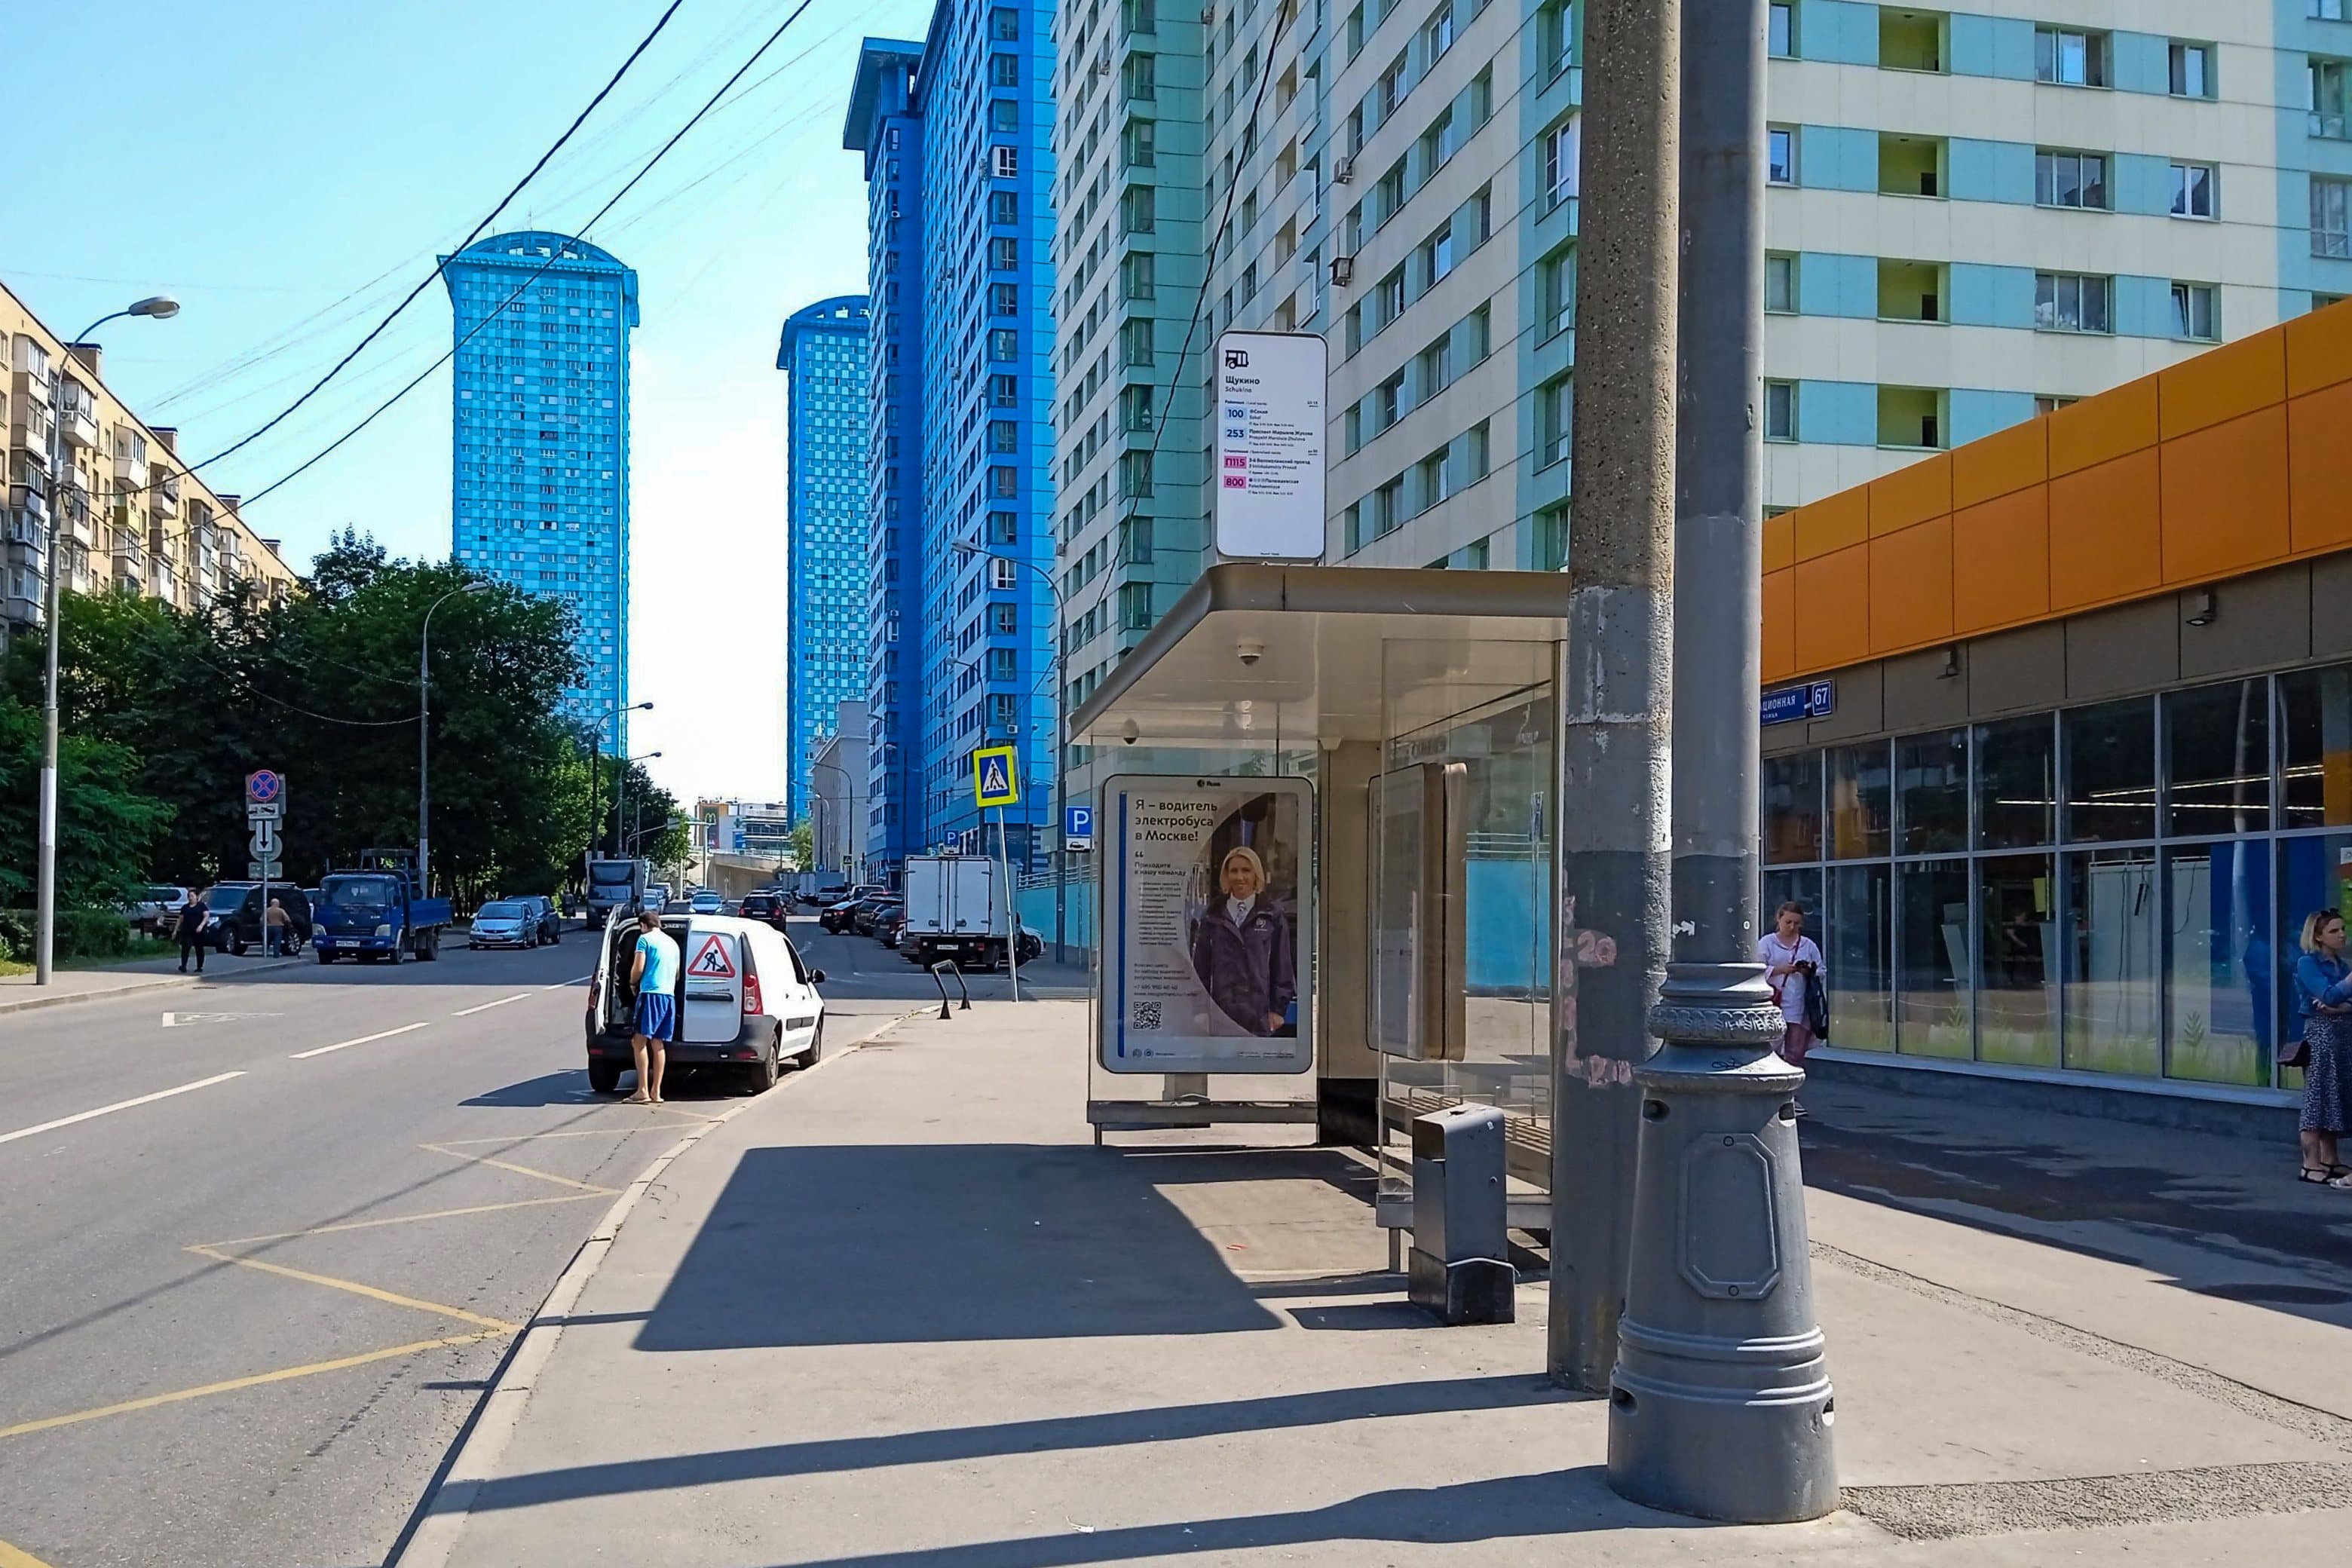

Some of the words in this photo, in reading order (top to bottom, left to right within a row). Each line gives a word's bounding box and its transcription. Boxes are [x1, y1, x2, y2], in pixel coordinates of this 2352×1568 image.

[1225, 375, 1260, 385] Щукино
[1228, 409, 1244, 418] 100
[1227, 429, 1244, 438] 253
[1225, 458, 1245, 467] П115
[1226, 477, 1244, 486] 800
[1815, 688, 1828, 705] 67
[1761, 695, 1796, 712] ЦИОННАЯ
[1135, 799, 1144, 810] Я
[1159, 802, 1217, 812] водитель
[1073, 810, 1089, 833] P
[1135, 816, 1214, 828] электробуса
[948, 831, 957, 844] P
[1135, 832, 1142, 841] в
[1145, 830, 1199, 842] Москве!
